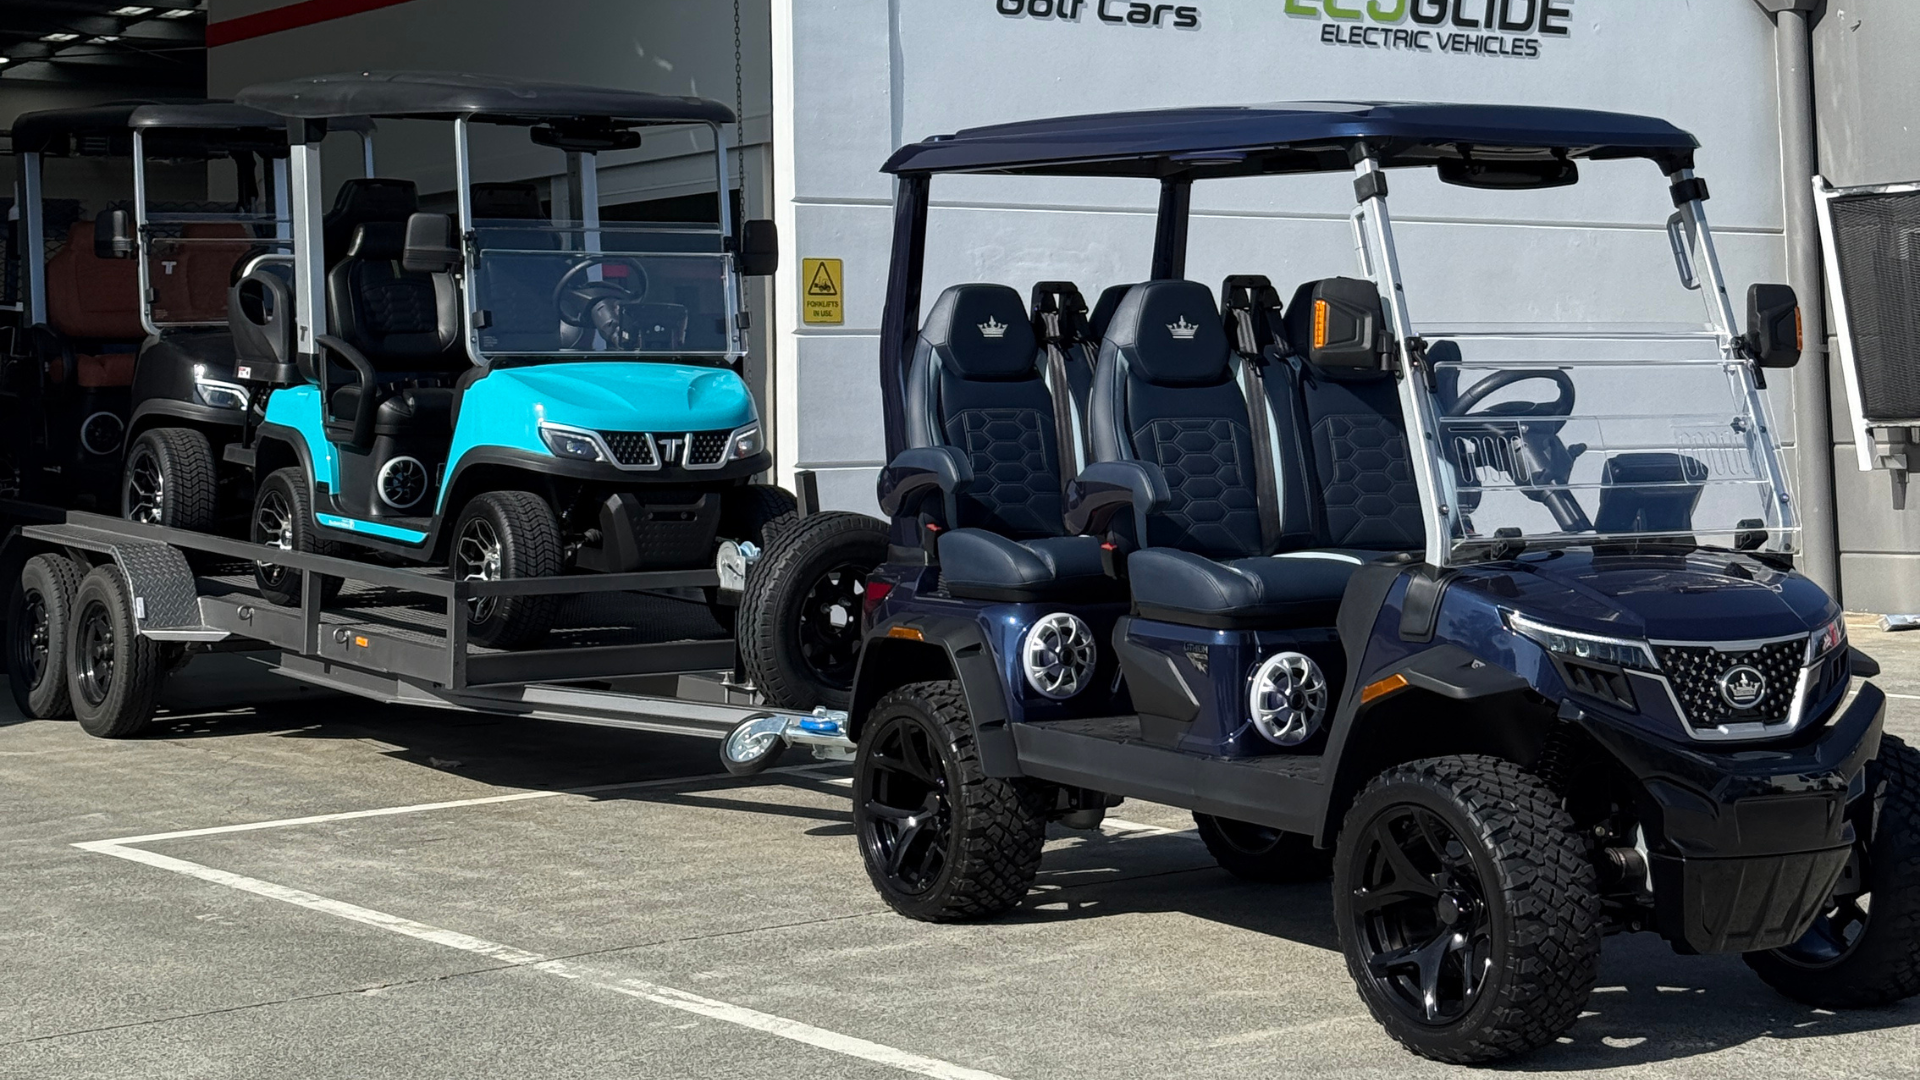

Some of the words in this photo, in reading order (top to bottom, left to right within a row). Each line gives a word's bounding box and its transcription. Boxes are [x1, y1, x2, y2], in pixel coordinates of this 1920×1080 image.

[1097, 0, 1198, 28] Cars
[1320, 23, 1431, 50] ELECTRIC
[1436, 31, 1539, 57] VEHICLES
[806, 300, 839, 308] FORKLIFTS
[812, 309, 820, 317] IN
[820, 309, 833, 317] USE
